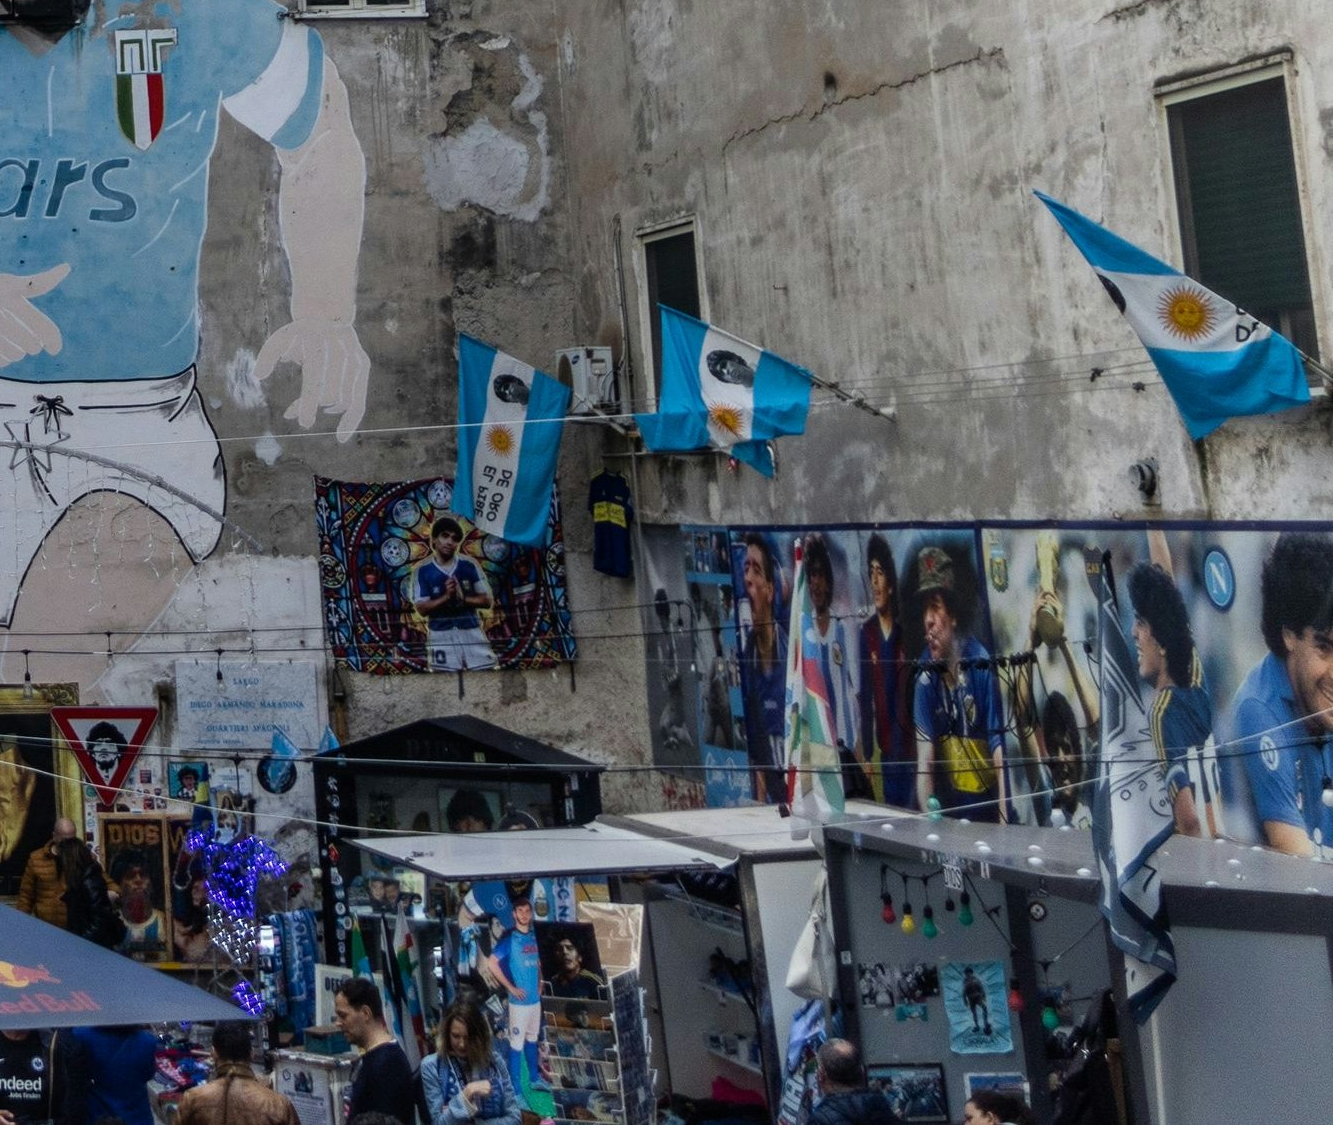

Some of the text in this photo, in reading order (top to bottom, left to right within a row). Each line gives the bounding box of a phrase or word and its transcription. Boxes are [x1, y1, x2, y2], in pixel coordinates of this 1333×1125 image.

[1209, 562, 1227, 595] N
[233, 677, 260, 686] LARGO
[190, 699, 305, 709] DIEGO ARMANDO MARADONA
